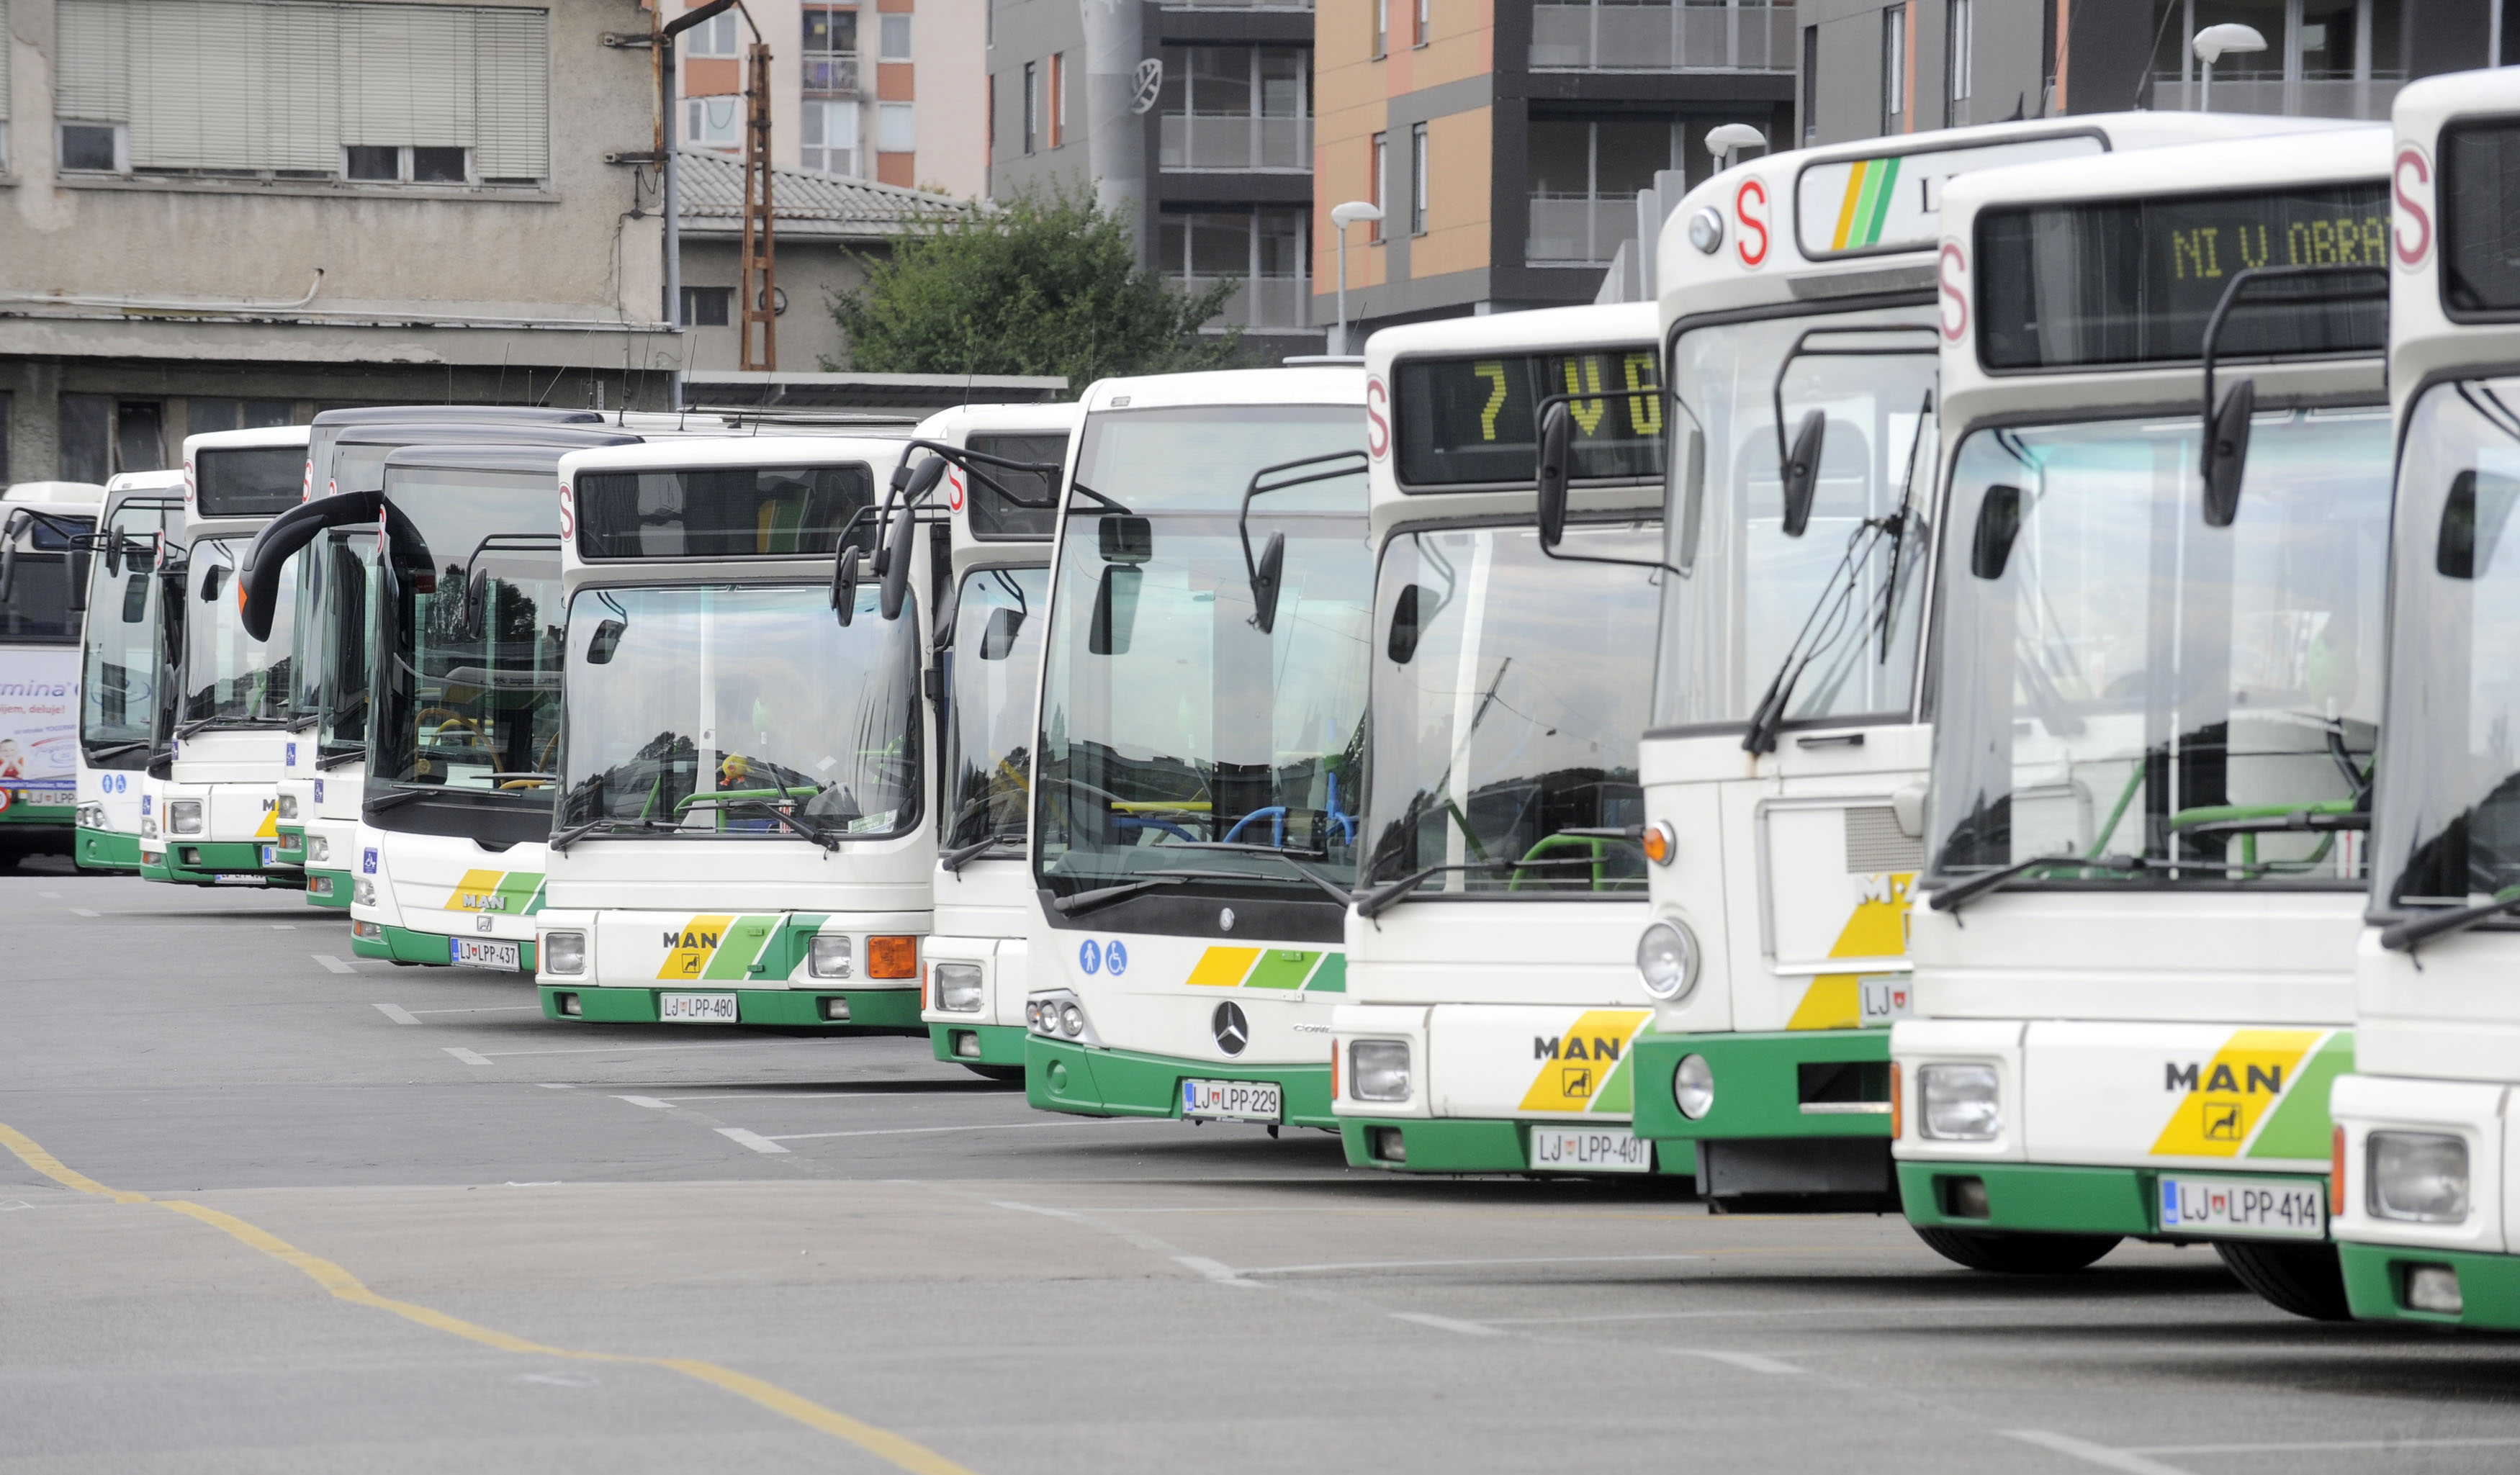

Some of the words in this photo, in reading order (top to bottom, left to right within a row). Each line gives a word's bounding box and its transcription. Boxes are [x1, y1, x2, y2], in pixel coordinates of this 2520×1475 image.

[1737, 181, 1768, 266] S
[2173, 227, 2222, 279] NI
[2288, 215, 2391, 267] OBRA
[1474, 359, 1507, 441] 7
[1564, 355, 1603, 436] V
[0, 680, 66, 697] mina
[462, 893, 507, 911] MAN
[459, 942, 471, 960] LJ
[663, 932, 718, 949] MAN
[665, 998, 678, 1016] LJ
[1865, 985, 1891, 1015] LJ
[1534, 1037, 1620, 1061] MAN
[2165, 1063, 2282, 1095] MAN
[1193, 1086, 1210, 1109] LJ
[1539, 1135, 1561, 1161] LJ
[2180, 1188, 2209, 1221] LJ
